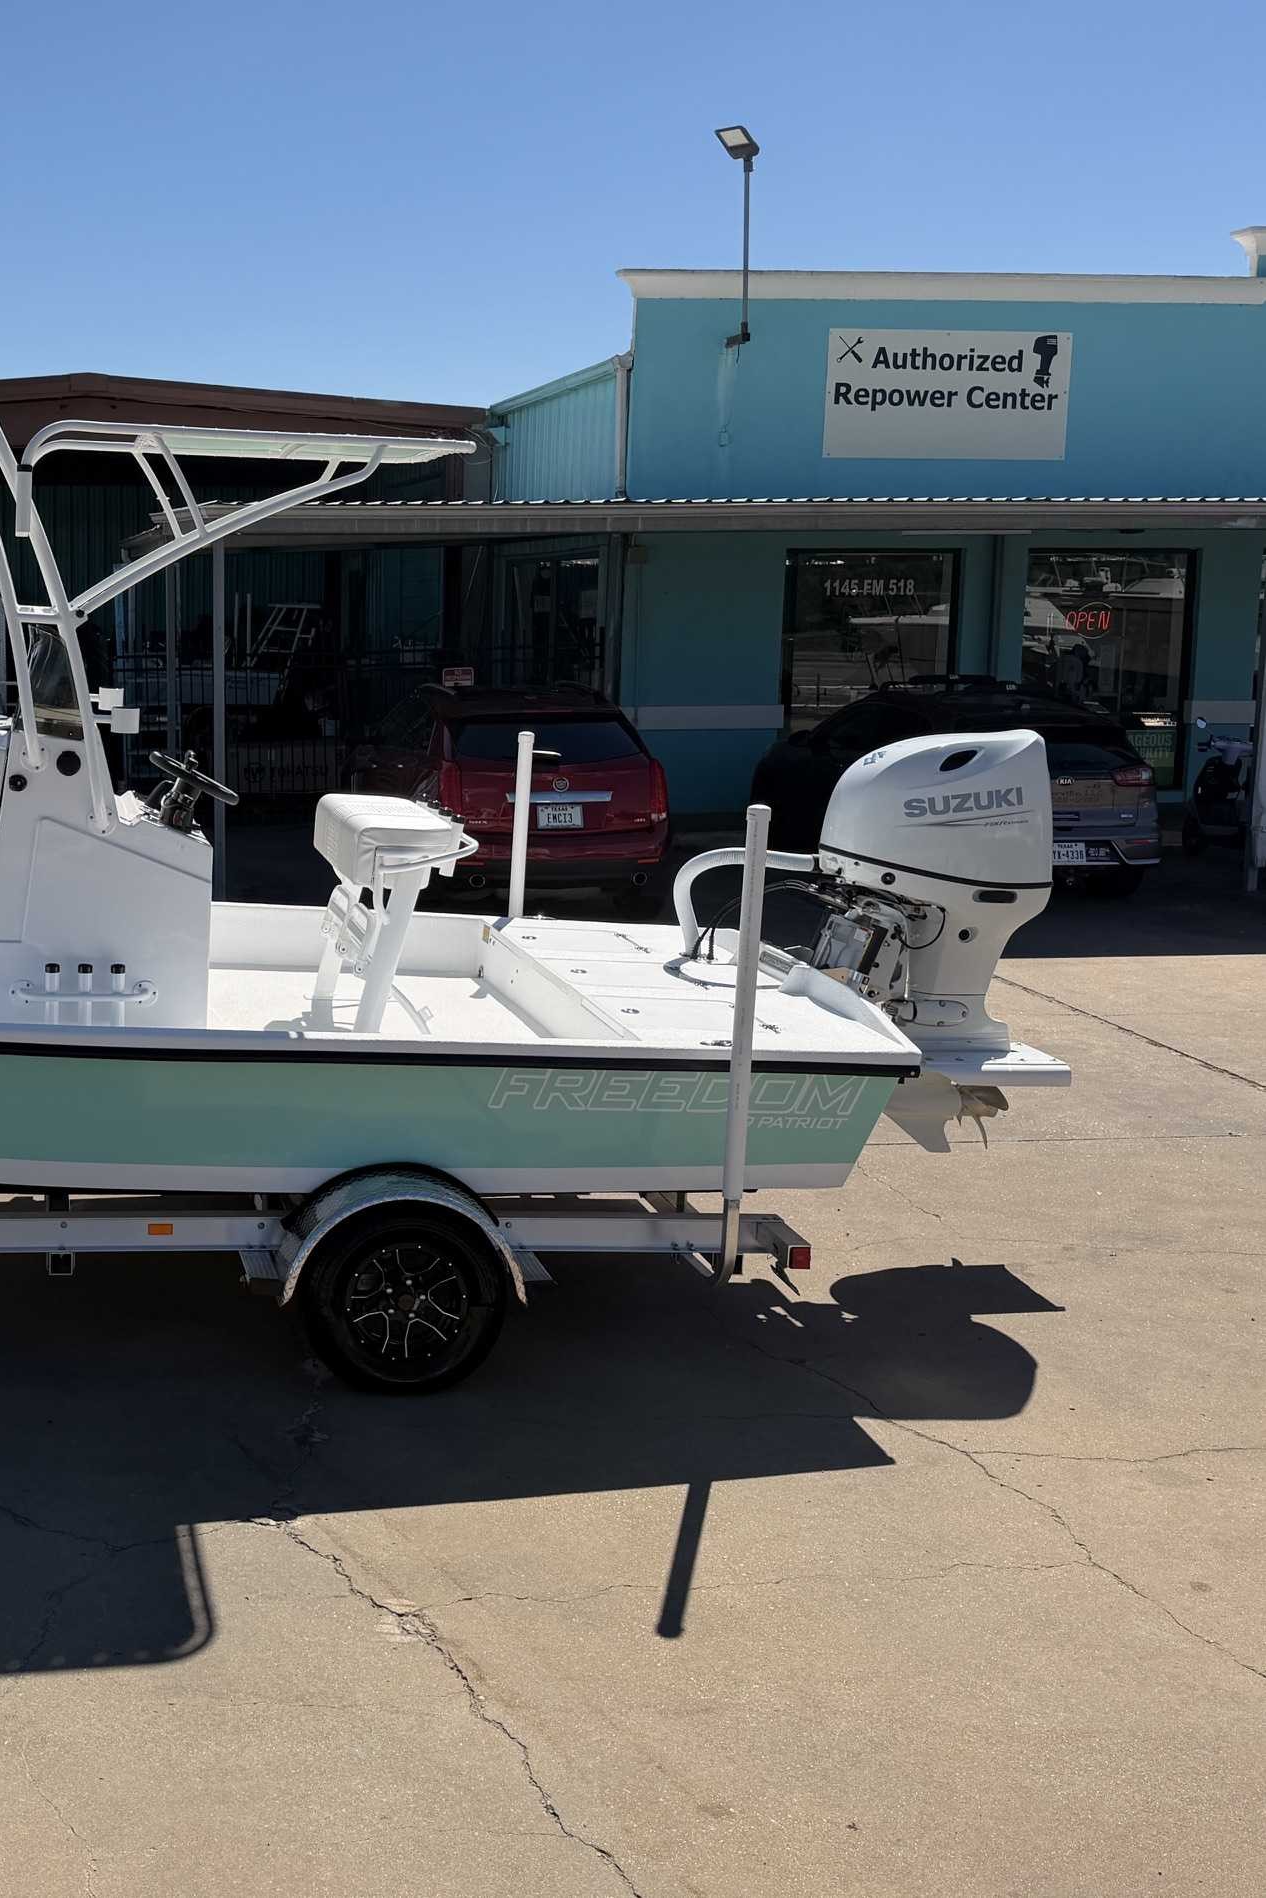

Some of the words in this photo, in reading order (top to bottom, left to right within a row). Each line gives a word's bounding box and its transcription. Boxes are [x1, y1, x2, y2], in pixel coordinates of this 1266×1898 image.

[871, 346, 1024, 373] Authorized
[833, 382, 958, 411] Repower
[966, 385, 1059, 411] Center
[824, 578, 859, 597] 1145
[863, 579, 884, 596] FM
[888, 579, 916, 596] 518
[1065, 611, 1111, 631] OPEN
[903, 786, 1024, 818] SUZUKI
[486, 1068, 869, 1116] FREEDOM
[757, 1116, 850, 1129] PATRIOT
